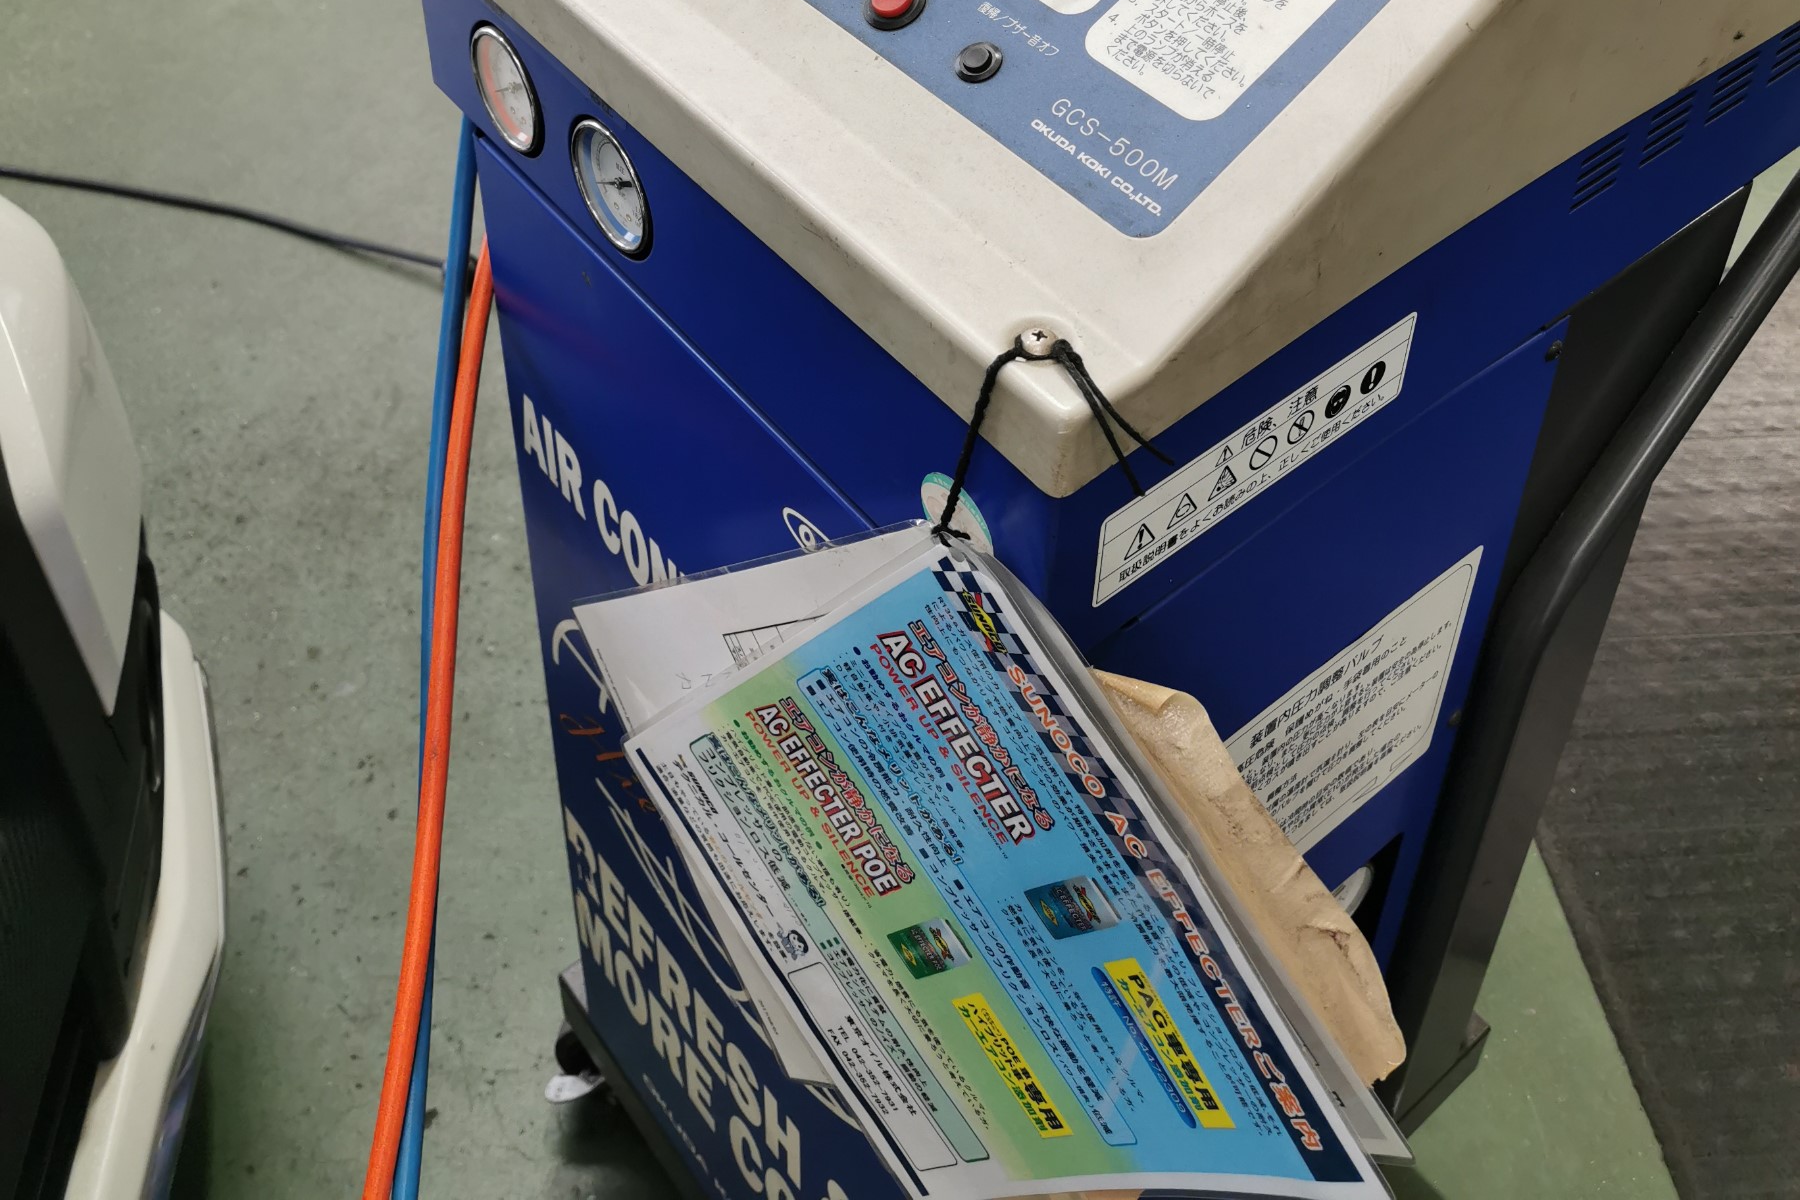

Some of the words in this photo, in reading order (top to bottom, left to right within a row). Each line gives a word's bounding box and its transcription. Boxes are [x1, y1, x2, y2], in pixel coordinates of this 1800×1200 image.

[1101, 41, 1151, 76] ください。
[1112, 31, 1216, 100] まで電源を切らないで
[1122, 21, 1217, 84] 上のランプが消える
[1132, 11, 1252, 88] ボタンを押してください。
[1028, 117, 1079, 155] OKUDA
[1076, 151, 1112, 178] KOKI
[1107, 175, 1165, 218] CO.,LTD.
[1047, 96, 1179, 191] GCS-500M
[524, 393, 586, 520] AIR
[594, 479, 686, 586] CON
[959, 589, 1010, 656] SUNOCO
[860, 657, 946, 778] お勧めするおクルマの例
[869, 642, 920, 711] POWER
[916, 713, 940, 741] UP
[937, 744, 952, 759] &
[949, 762, 1009, 844] SILENCE
[878, 626, 929, 680] AC
[909, 674, 1040, 846] EFFECTER
[906, 618, 1058, 833] エアコンが静かになる
[1248, 632, 1384, 749] 装置内圧力調整バルブ
[686, 769, 718, 814] SUNOCO
[697, 751, 791, 891] フリクションロス低減
[704, 746, 784, 863] コンプレッサーの
[744, 710, 791, 773] POWER
[790, 777, 810, 801] UP
[808, 804, 821, 818] &
[819, 821, 875, 898] SILENCE
[755, 701, 792, 737] AC
[776, 732, 867, 844] EFFECTER
[847, 841, 902, 895] POE
[778, 695, 919, 885] エアコンが静かになる
[815, 698, 915, 836] エアコン使用時の燃費改善
[1003, 661, 1108, 800] SUNOCO
[1103, 807, 1150, 860] AC
[1144, 867, 1328, 1151] EFFECTERご案内
[566, 807, 800, 1190] REFRESH
[576, 891, 716, 1132] MORE
[826, 1028, 842, 1046] FAX
[836, 1026, 851, 1042] TEL
[966, 1002, 1024, 1080] ハイブリッド車
[1097, 980, 1122, 1007] 特許
[1135, 1041, 1190, 1113] 4472309
[1115, 978, 1206, 1111] カーエアコン添加剤
[1125, 973, 1221, 1111] PAG車専用
[843, 1014, 918, 1115] 東京オイル株式会社
[957, 1004, 1048, 1131] カーエアコン添加剤
[1019, 1080, 1065, 1129] 専用
